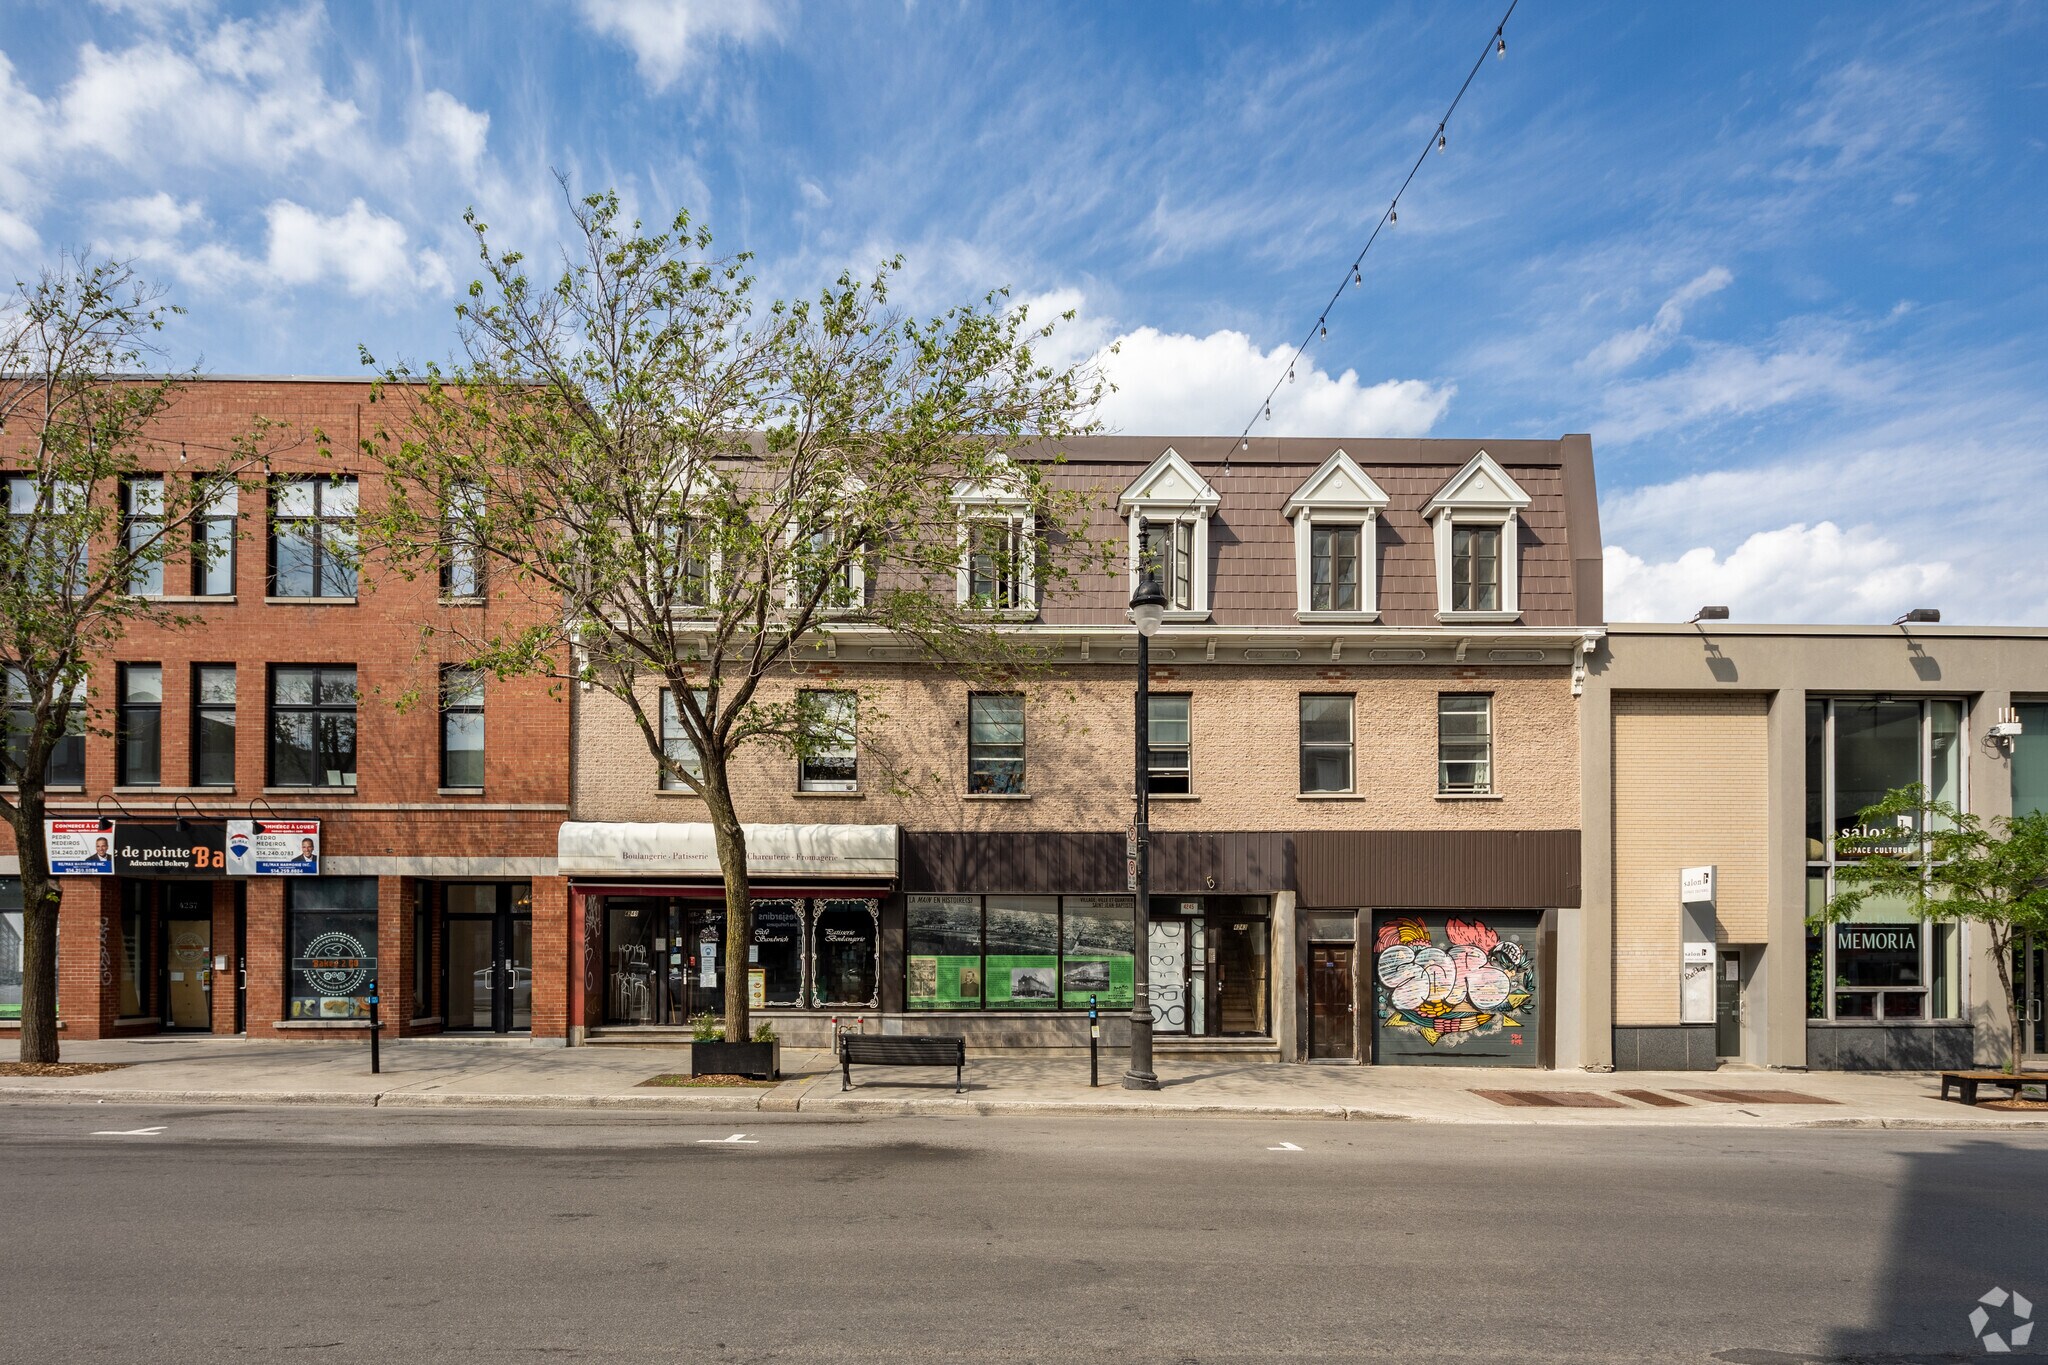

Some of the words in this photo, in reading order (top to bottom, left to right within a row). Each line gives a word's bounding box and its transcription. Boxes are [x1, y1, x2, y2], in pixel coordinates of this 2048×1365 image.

[121, 846, 140, 858] de
[143, 846, 190, 860] pointe
[1874, 846, 1912, 854] CULTUREL
[622, 851, 667, 861] Boulangerie
[673, 852, 709, 860] Patisserie
[747, 852, 790, 861] Charcuterie
[796, 853, 838, 863] Fromagerie
[164, 860, 190, 868] Bakery
[1683, 878, 1702, 887] salon
[1838, 932, 1916, 949] MEMORIA
